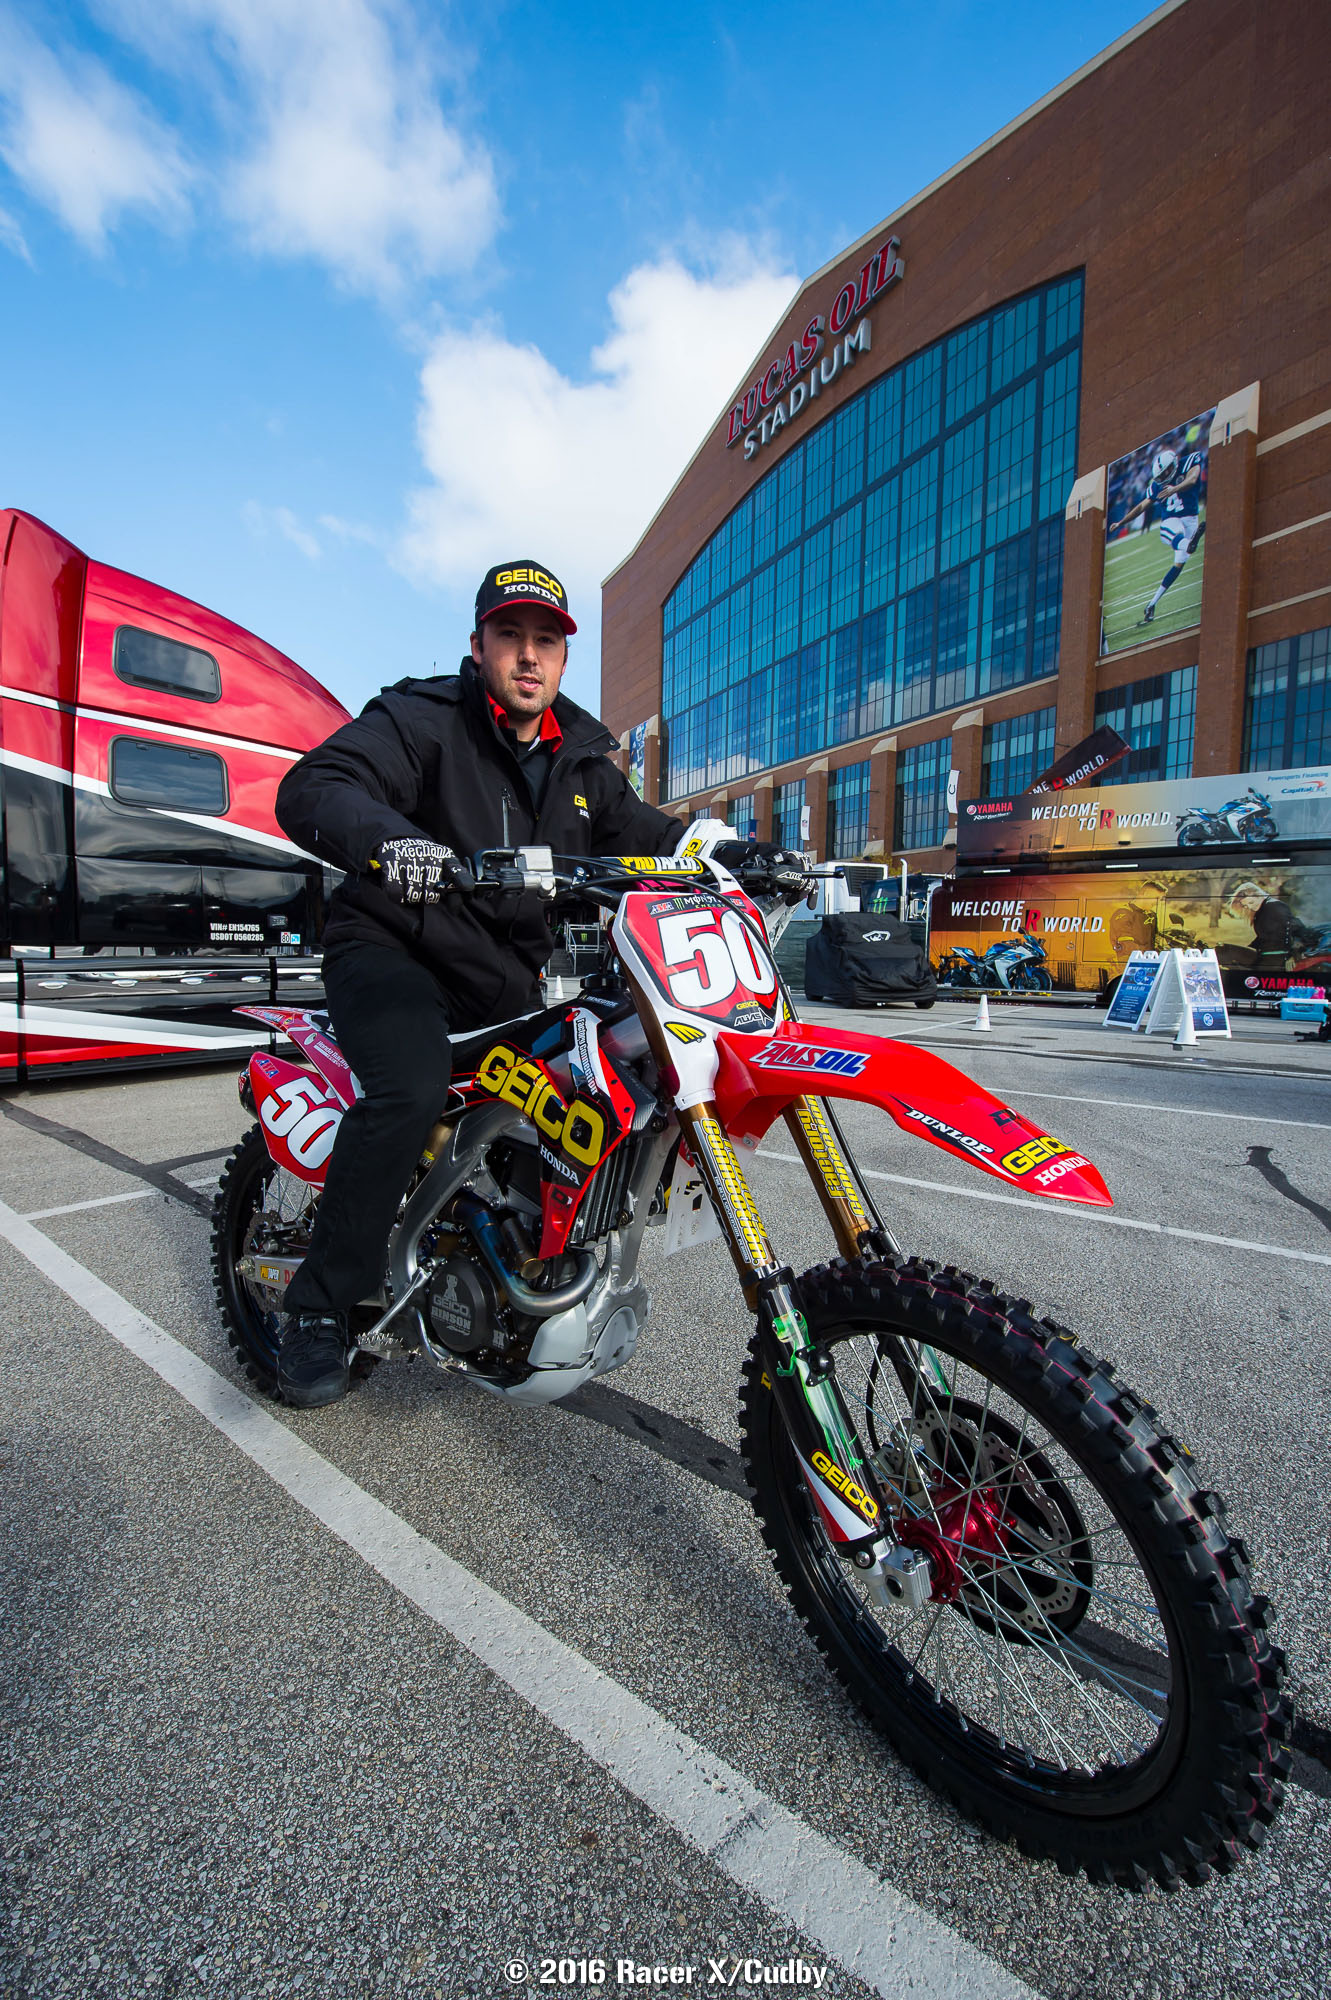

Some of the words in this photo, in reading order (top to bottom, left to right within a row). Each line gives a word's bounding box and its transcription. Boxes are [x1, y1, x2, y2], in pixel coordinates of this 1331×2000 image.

[726, 314, 825, 448] LUCAS
[829, 235, 905, 335] OIL
[744, 317, 872, 460] STADIUM
[495, 568, 563, 599] GEICO
[503, 583, 560, 607] HONDA
[1065, 755, 1109, 786] WORLD.
[977, 801, 1013, 814] YAMAHA
[1031, 802, 1100, 820] WELCOME
[1078, 817, 1097, 831] TO
[1099, 808, 1115, 830] R
[1116, 811, 1174, 829] WORLD.
[650, 901, 675, 915] AMA
[951, 900, 1026, 917] WELCOME
[1002, 917, 1022, 933] TO
[1025, 909, 1042, 932] R
[1043, 916, 1106, 933] WORLD.
[210, 922, 228, 931] VIN#
[210, 932, 234, 941] USDOT
[233, 933, 264, 941] 0560285
[656, 908, 776, 1008] 50
[1260, 977, 1315, 990] YAMAHA
[575, 1017, 587, 1047] Factory
[578, 1046, 598, 1096] Connection
[752, 1040, 868, 1075] AMSOIL
[477, 1044, 605, 1167] GEICO
[260, 1075, 345, 1170] 50
[905, 1108, 994, 1153] DUNLOP
[540, 1143, 581, 1187] HONDA
[796, 1109, 847, 1198] Factory
[1000, 1135, 1076, 1175] GEIC
[1034, 1156, 1092, 1187] HONDA
[433, 1294, 471, 1318] GEICO
[811, 1451, 878, 1520] GEICO
